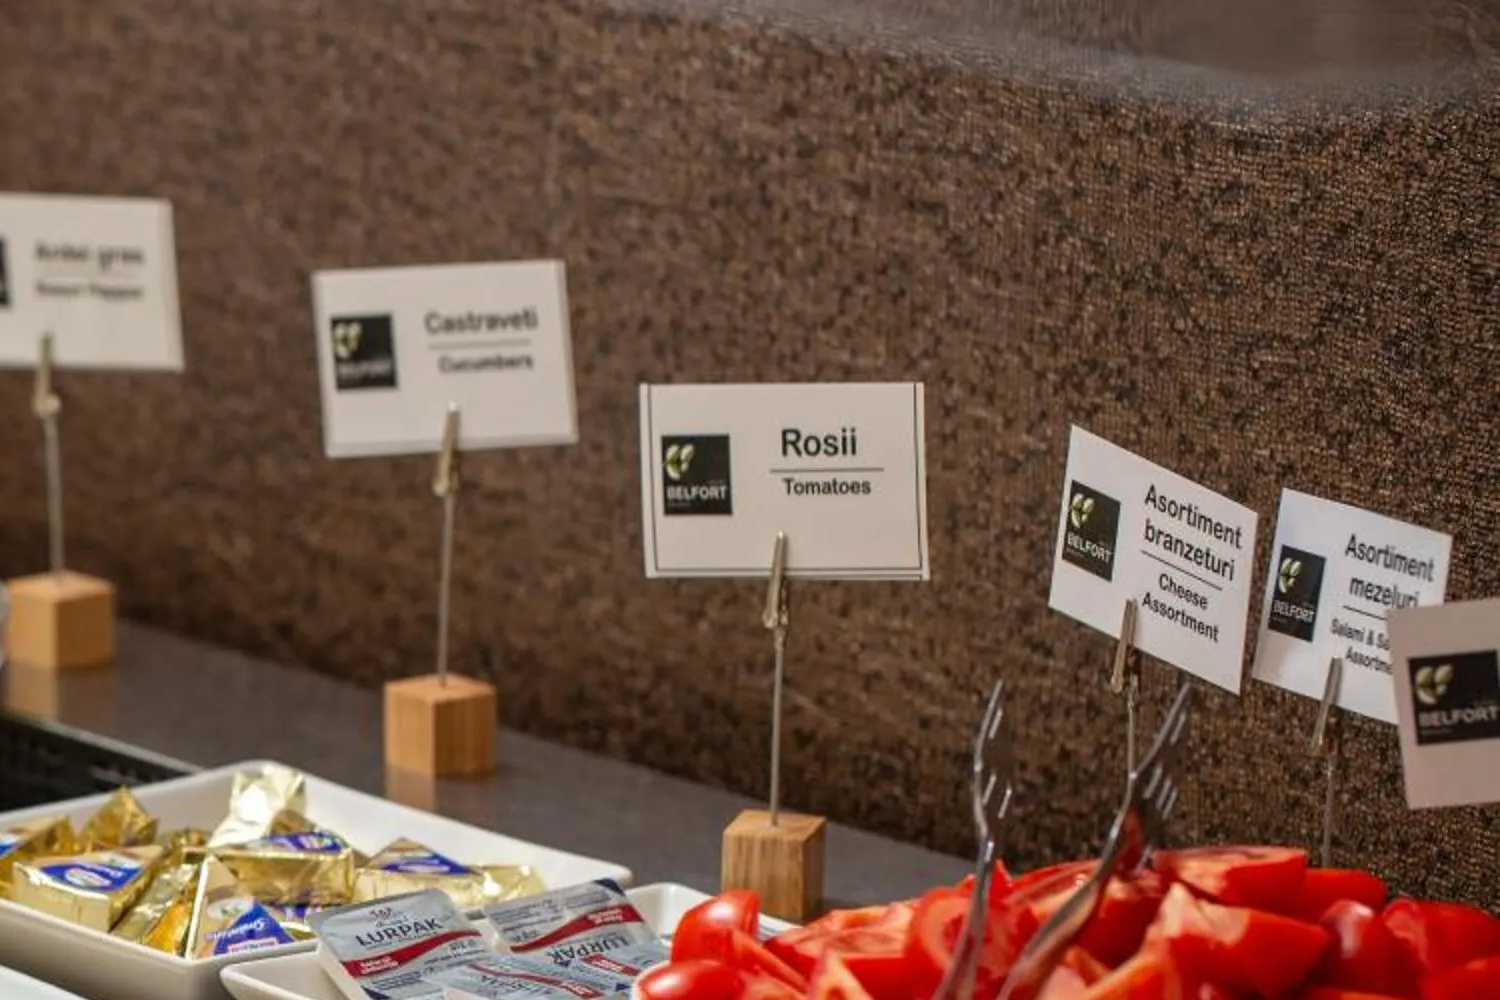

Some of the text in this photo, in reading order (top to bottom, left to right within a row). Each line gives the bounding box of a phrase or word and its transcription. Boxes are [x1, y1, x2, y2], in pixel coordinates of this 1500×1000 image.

[424, 307, 539, 334] Castraveti
[437, 354, 534, 374] Cucumbers
[781, 427, 857, 457] Rosii
[667, 485, 726, 500] BELFORT
[782, 478, 871, 496] Tomatoes
[1144, 484, 1243, 550] Asortiment
[1067, 532, 1113, 562] BELFORT
[1144, 518, 1234, 581] branzeturi
[1345, 533, 1435, 582] Asortiment
[1159, 573, 1208, 611] Cheese
[1142, 592, 1219, 643] Assortment
[1273, 601, 1316, 624] BELFORT
[1331, 617, 1365, 643] Salami
[1345, 645, 1393, 675] Assortme
[1419, 705, 1498, 727] BELFORT
[356, 918, 443, 946] LURPAK
[548, 934, 629, 964] LURPAK
